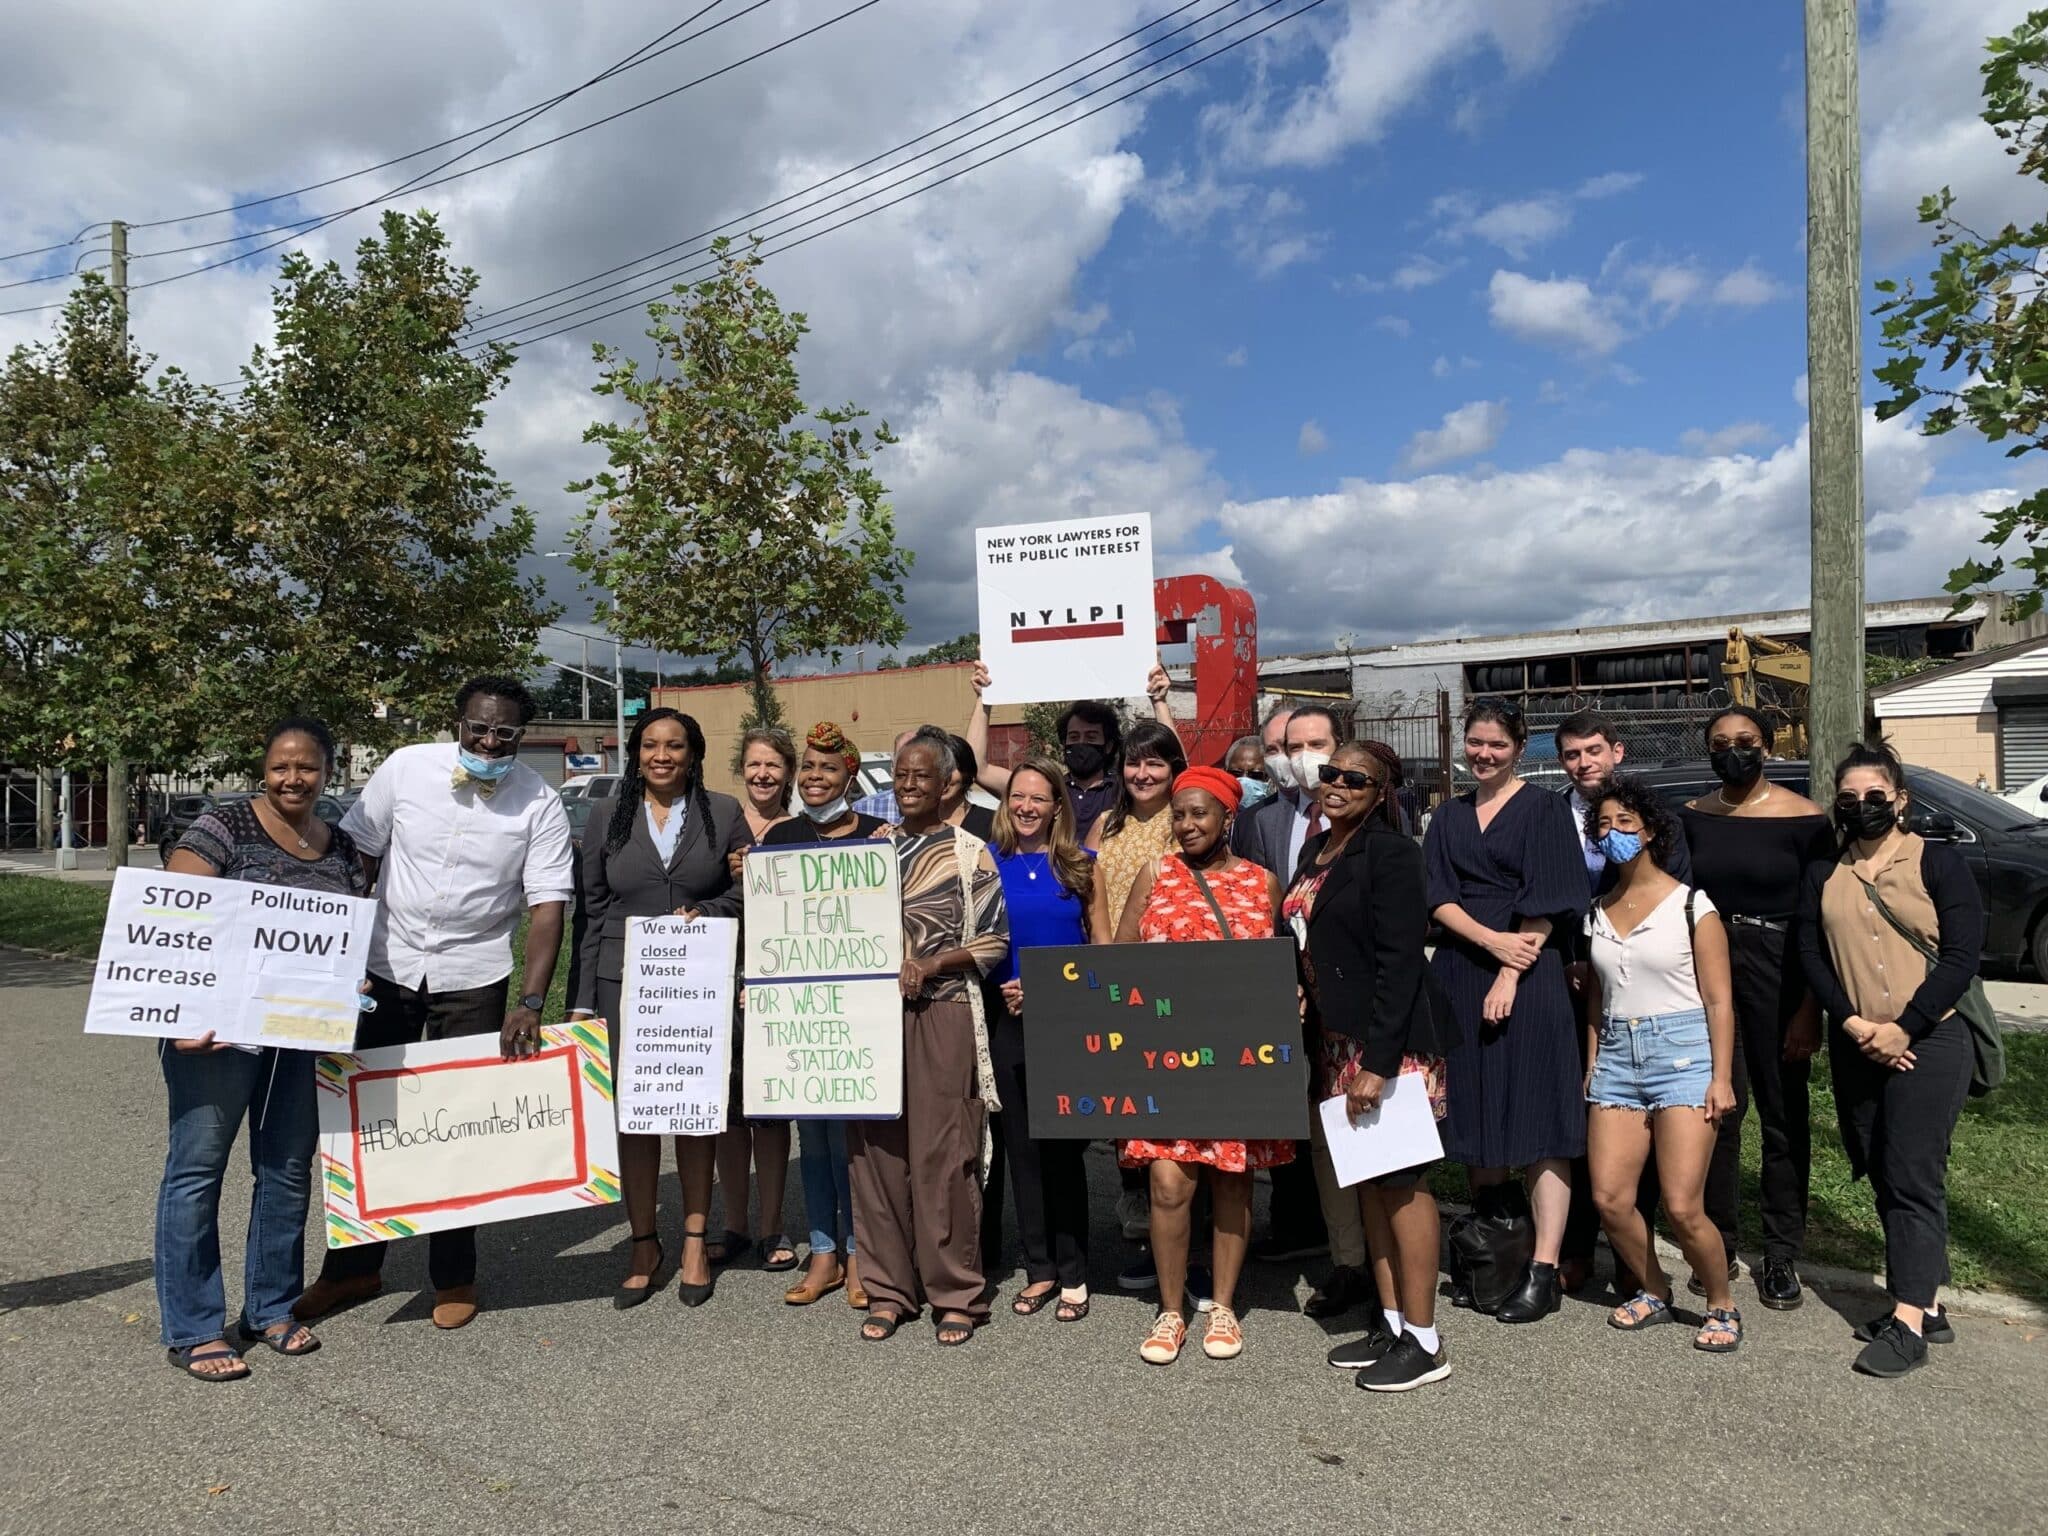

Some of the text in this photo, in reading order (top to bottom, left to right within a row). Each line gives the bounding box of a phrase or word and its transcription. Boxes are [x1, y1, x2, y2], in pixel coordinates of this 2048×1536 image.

[987, 526, 1140, 549] NEW YORK LAWYERS FOR
[987, 541, 1141, 565] THE PUBLIC INTEREST
[1010, 604, 1124, 628] NYLPI
[745, 851, 887, 896] WE DEMAND
[142, 886, 212, 910] STOP
[250, 890, 349, 916] Pollution
[784, 895, 865, 936] LEGAL
[127, 923, 213, 952] Waste
[642, 922, 707, 935] We want
[641, 944, 687, 957] closed
[759, 935, 888, 977] STANDARDS
[106, 961, 217, 987] Increase
[640, 964, 686, 977] Waste
[638, 986, 716, 1000] facilities in
[749, 984, 845, 1015] FOR WASTE
[129, 1003, 181, 1024] and
[638, 1003, 663, 1015] our
[636, 1026, 713, 1039] residential
[762, 1020, 852, 1047] TRANSFER
[1085, 1032, 1123, 1053] UP
[635, 1041, 712, 1056] community
[786, 1047, 874, 1073] STATIONS
[1144, 1044, 1292, 1070] YOUR ACT
[634, 1062, 704, 1076] and clean
[633, 1079, 684, 1093] air and
[763, 1076, 878, 1105] IN QUEENS
[632, 1102, 720, 1116] water!! It is
[1056, 1095, 1160, 1116] ROYAL
[627, 1116, 719, 1131] our RIGHT.
